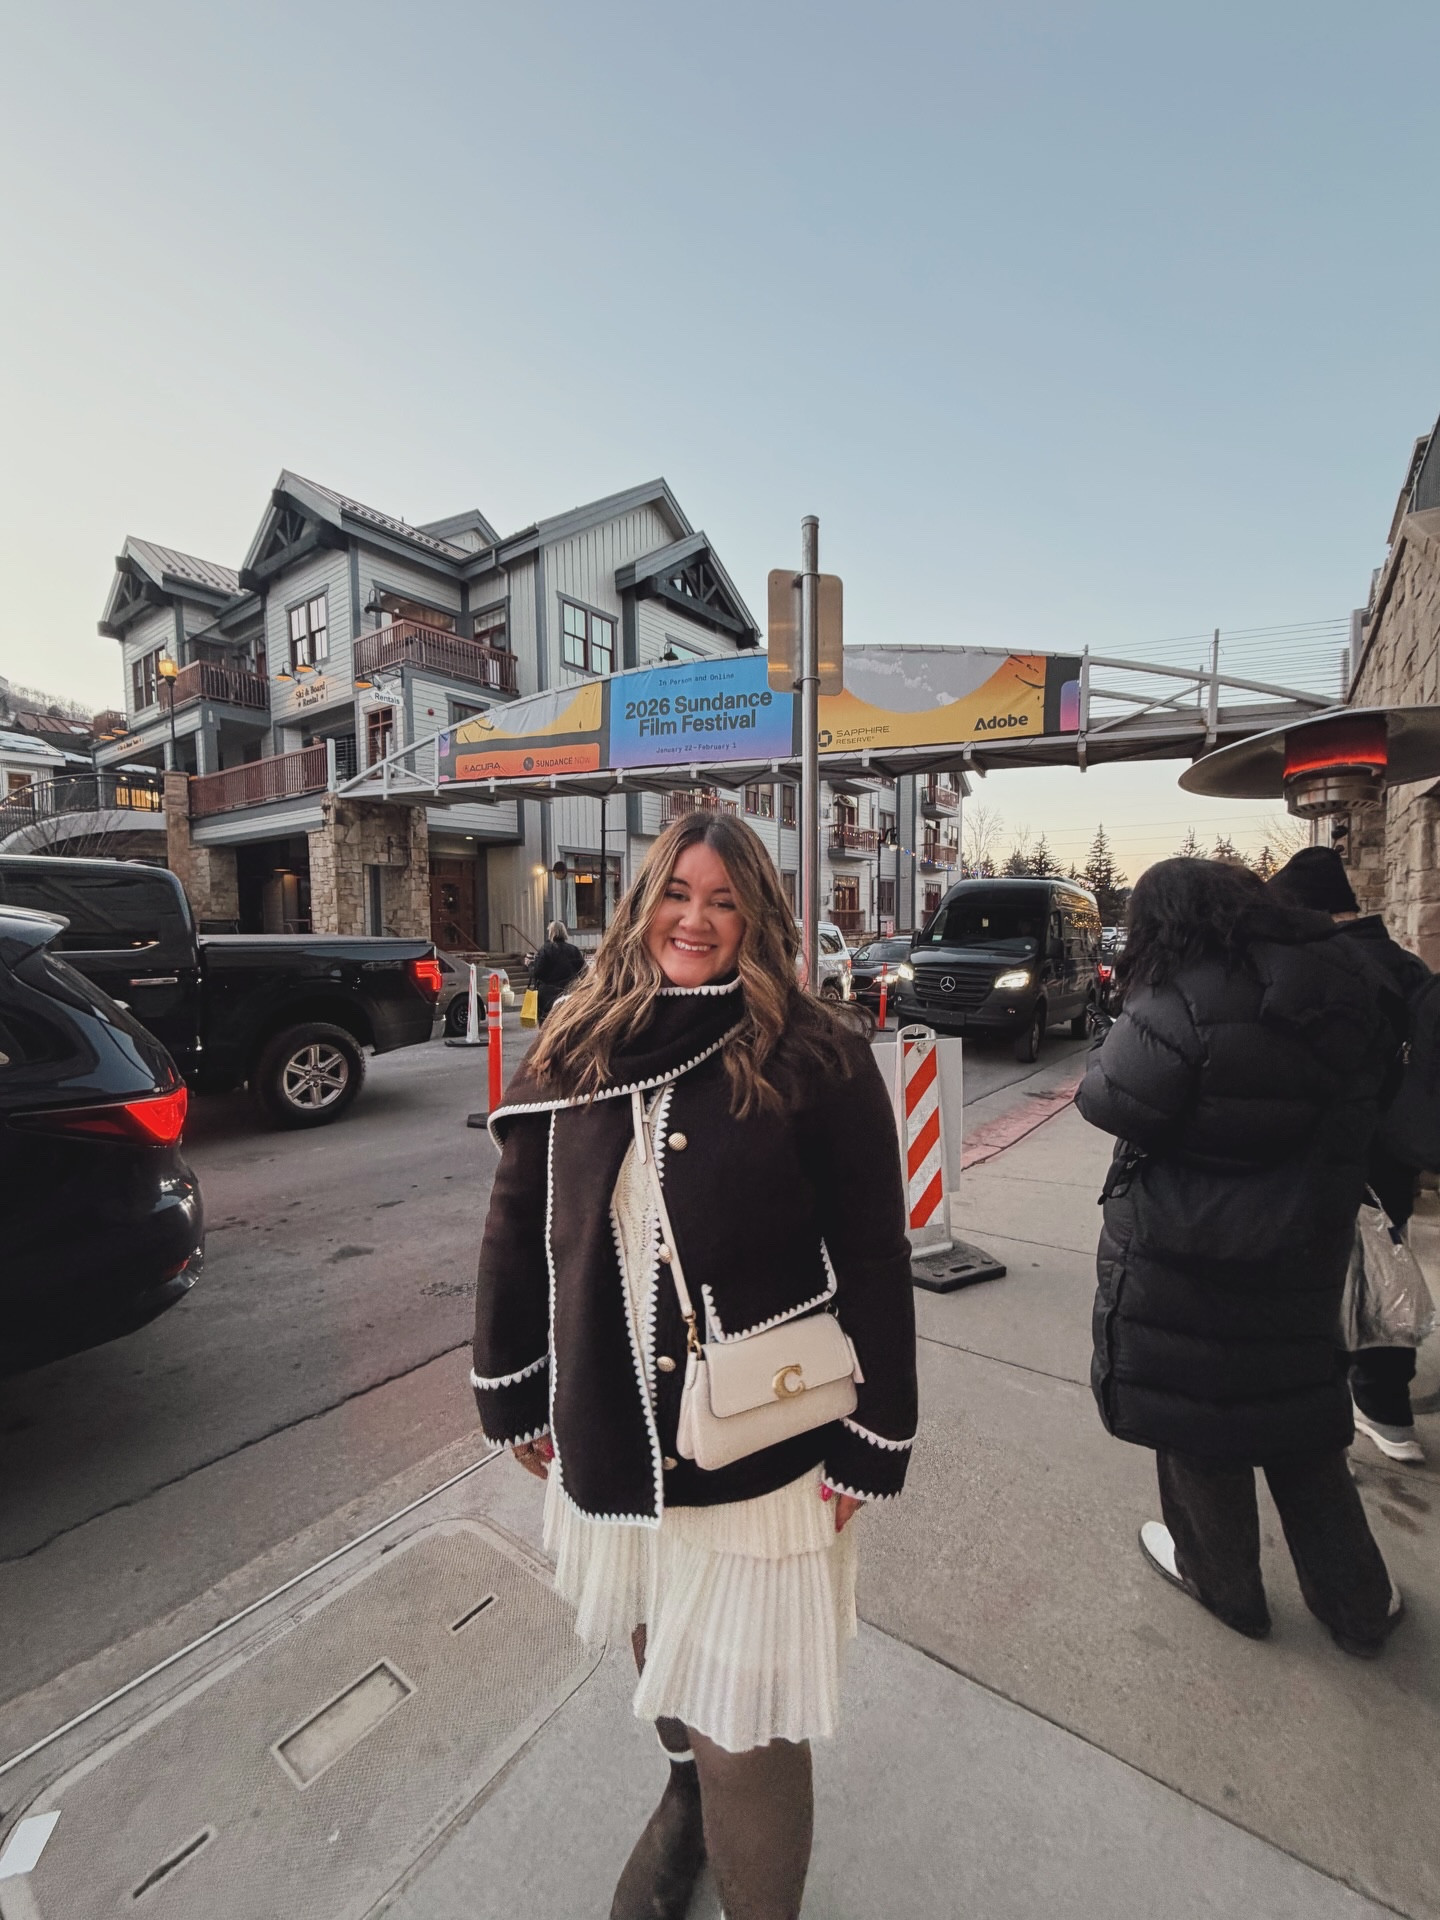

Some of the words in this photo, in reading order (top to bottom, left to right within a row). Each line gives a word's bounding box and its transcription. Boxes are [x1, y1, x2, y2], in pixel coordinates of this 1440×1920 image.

[659, 679, 667, 687] In
[670, 677, 692, 685] Person
[695, 674, 707, 682] and
[710, 673, 734, 681] Online
[296, 689, 304, 699] Ski
[310, 681, 325, 693] Board
[303, 694, 319, 707] Rental
[374, 692, 400, 705] Rentals
[625, 697, 671, 720] 2026
[674, 691, 773, 714] Sundance
[640, 718, 677, 737] Film
[682, 709, 756, 733] Festival
[973, 714, 1029, 731] Adobe
[836, 725, 890, 737] SAPPHIRE
[656, 746, 682, 754] January
[469, 762, 501, 772] ACURA
[536, 757, 573, 768] SUNDANCE
[574, 756, 590, 765] NOW
